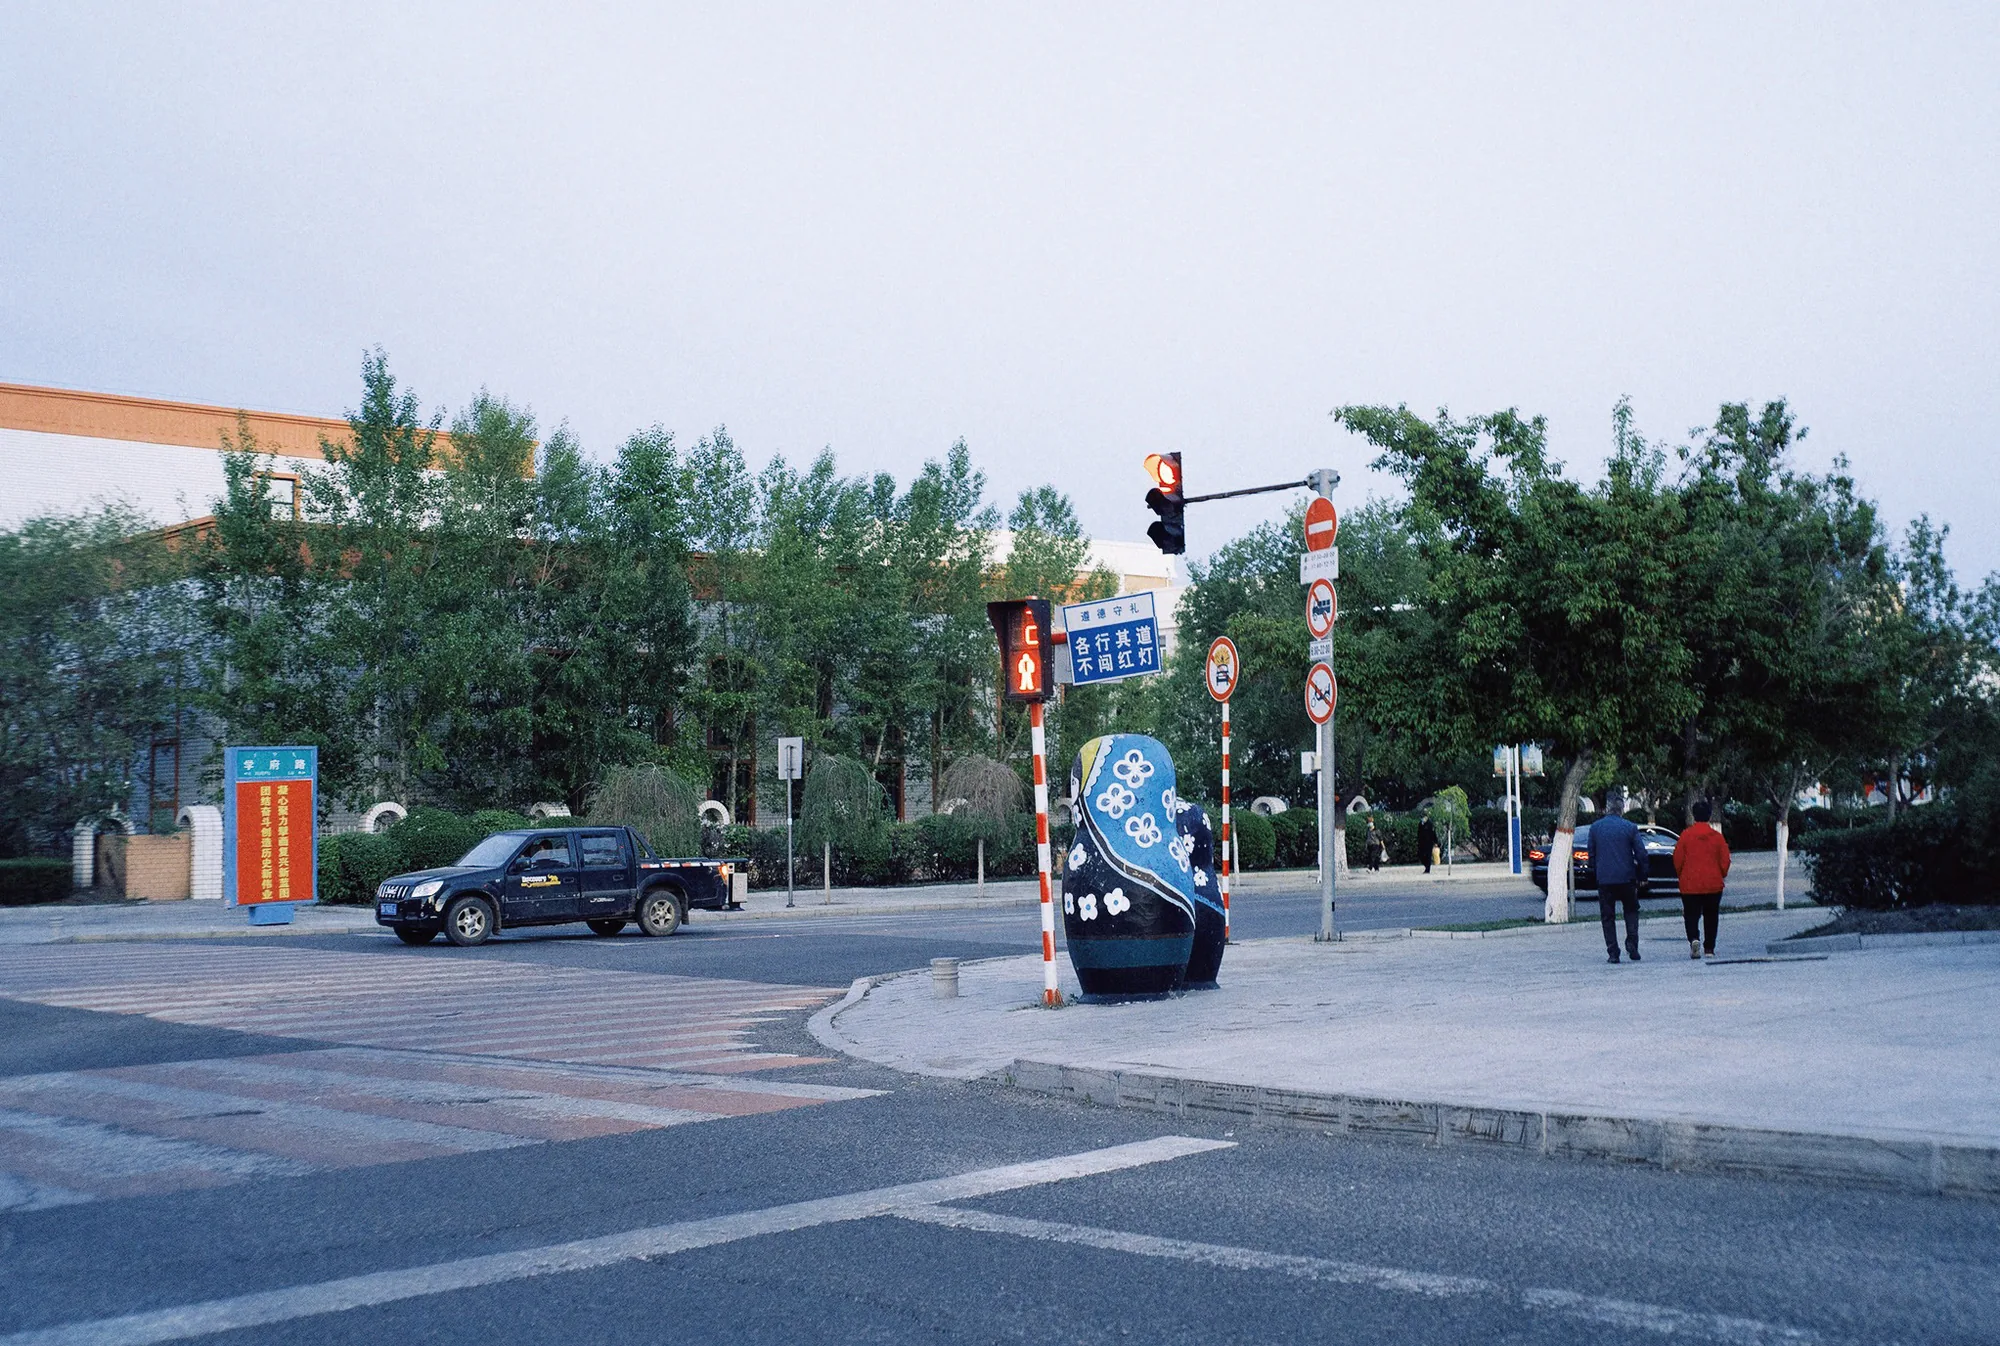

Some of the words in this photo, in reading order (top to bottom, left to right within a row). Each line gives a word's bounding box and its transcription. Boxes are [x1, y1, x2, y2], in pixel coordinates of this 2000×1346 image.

[1080, 602, 1140, 622] 遵德守礼
[1075, 625, 1153, 656] 各行其道
[1076, 647, 1154, 677] 不闯红灯
[243, 759, 306, 771] 学府路
[260, 785, 273, 900] 团结奋斗创造历史新伟业
